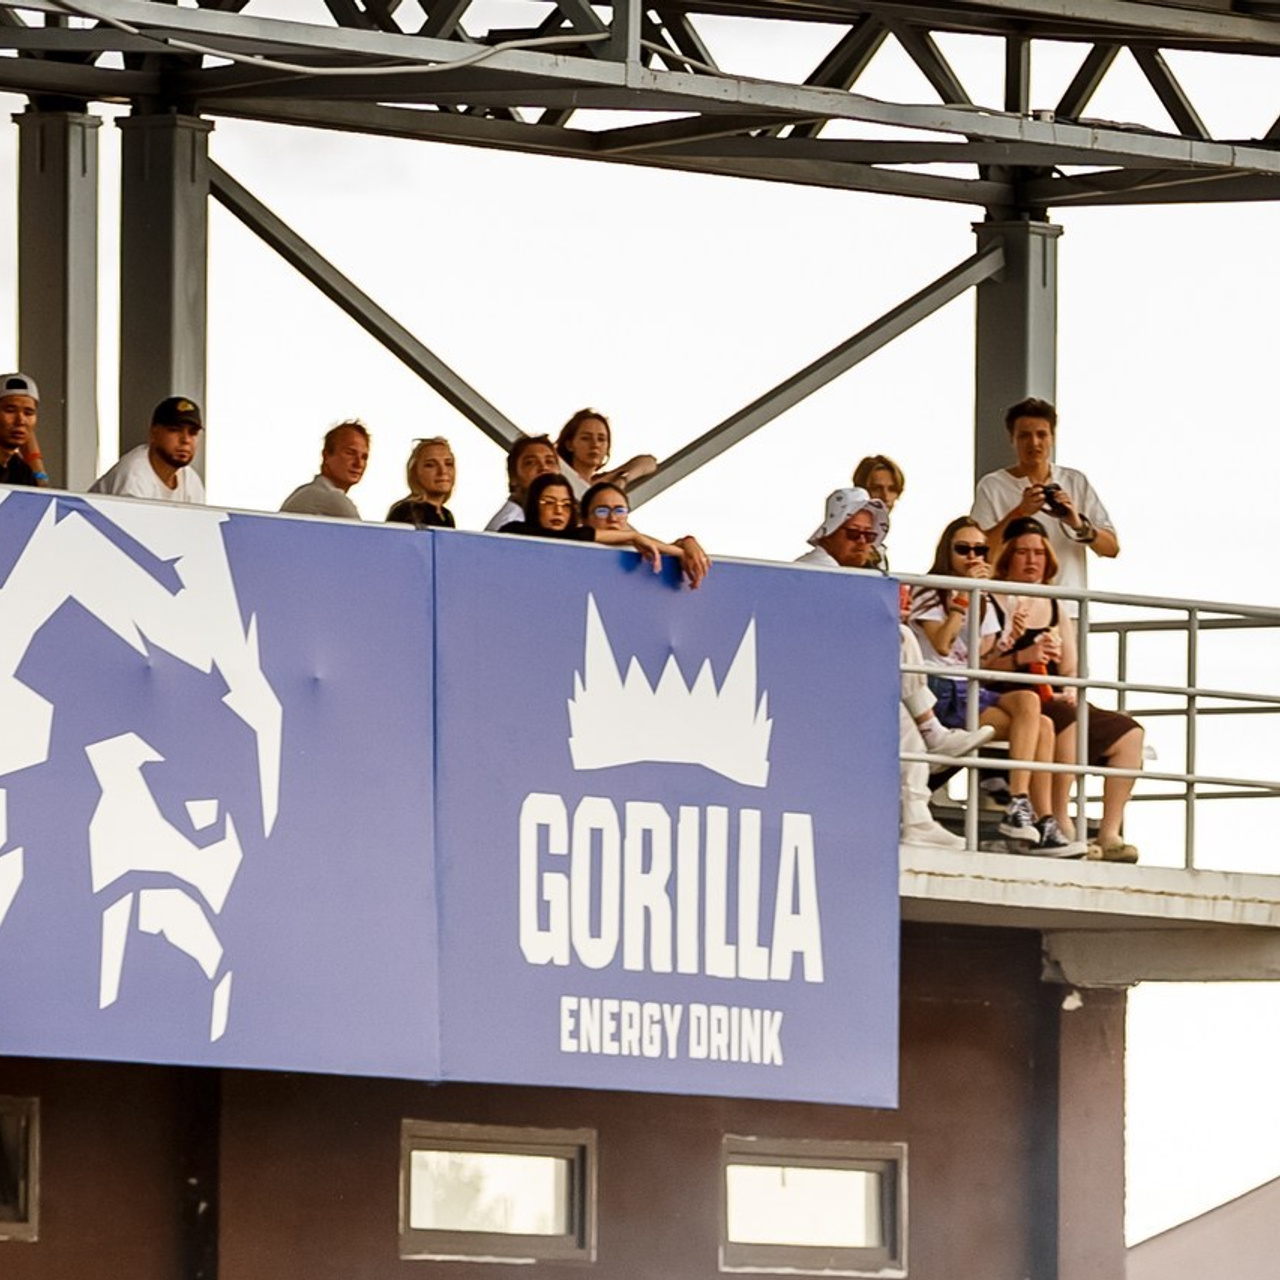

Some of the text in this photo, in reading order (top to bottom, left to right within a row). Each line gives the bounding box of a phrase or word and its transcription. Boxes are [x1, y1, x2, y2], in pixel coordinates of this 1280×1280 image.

[518, 792, 824, 984] GORILLA
[559, 996, 784, 1066] ENERGY DRINK
